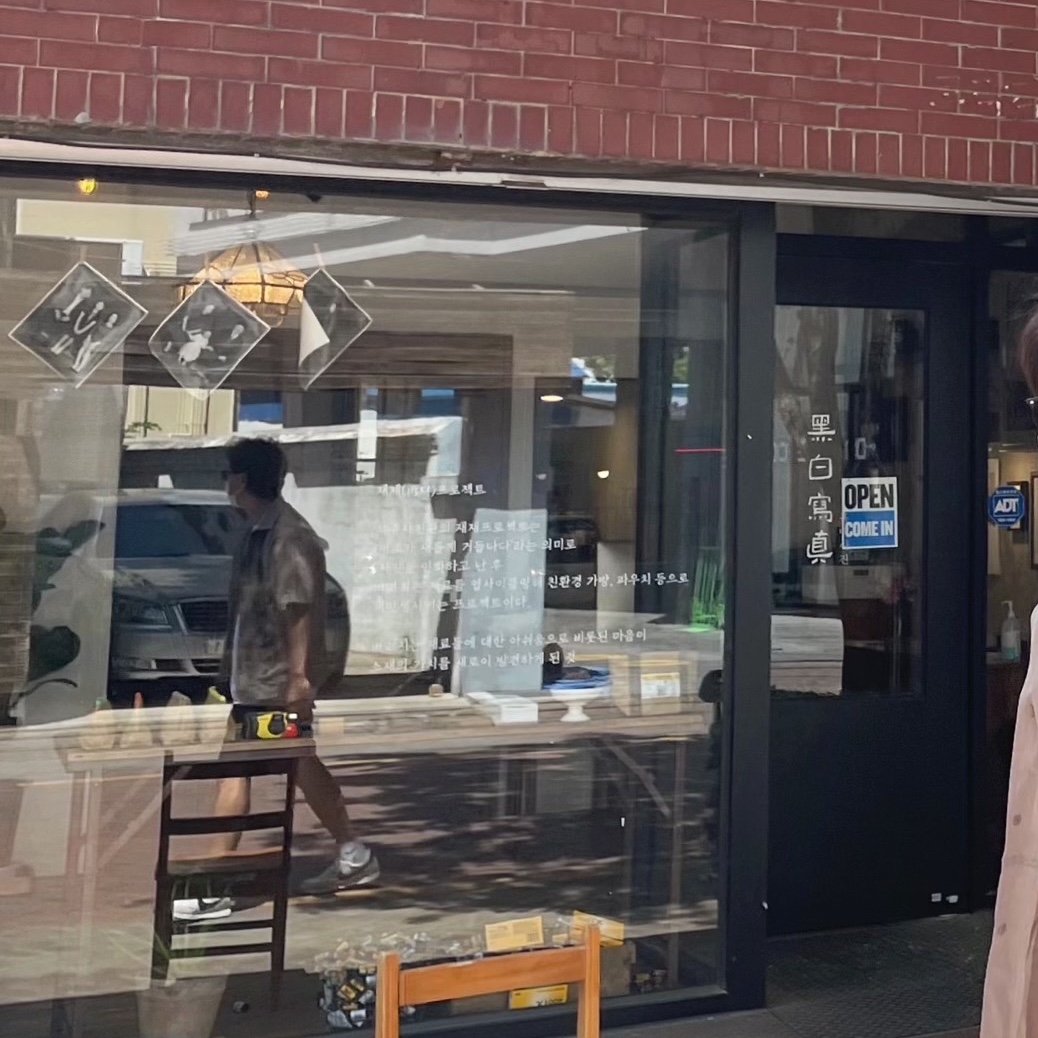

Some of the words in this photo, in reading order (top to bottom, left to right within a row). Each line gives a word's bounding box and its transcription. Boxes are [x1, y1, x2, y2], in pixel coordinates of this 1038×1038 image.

[844, 483, 894, 509] OPEN
[994, 498, 1019, 513] ADT
[845, 520, 878, 538] COME
[880, 520, 894, 536] IN
[541, 537, 577, 551] 의미로
[547, 574, 582, 589] 친환경
[616, 571, 651, 586] 파우치
[654, 571, 689, 586] 등으로
[612, 628, 647, 643] 마음이
[548, 650, 561, 665] 된
